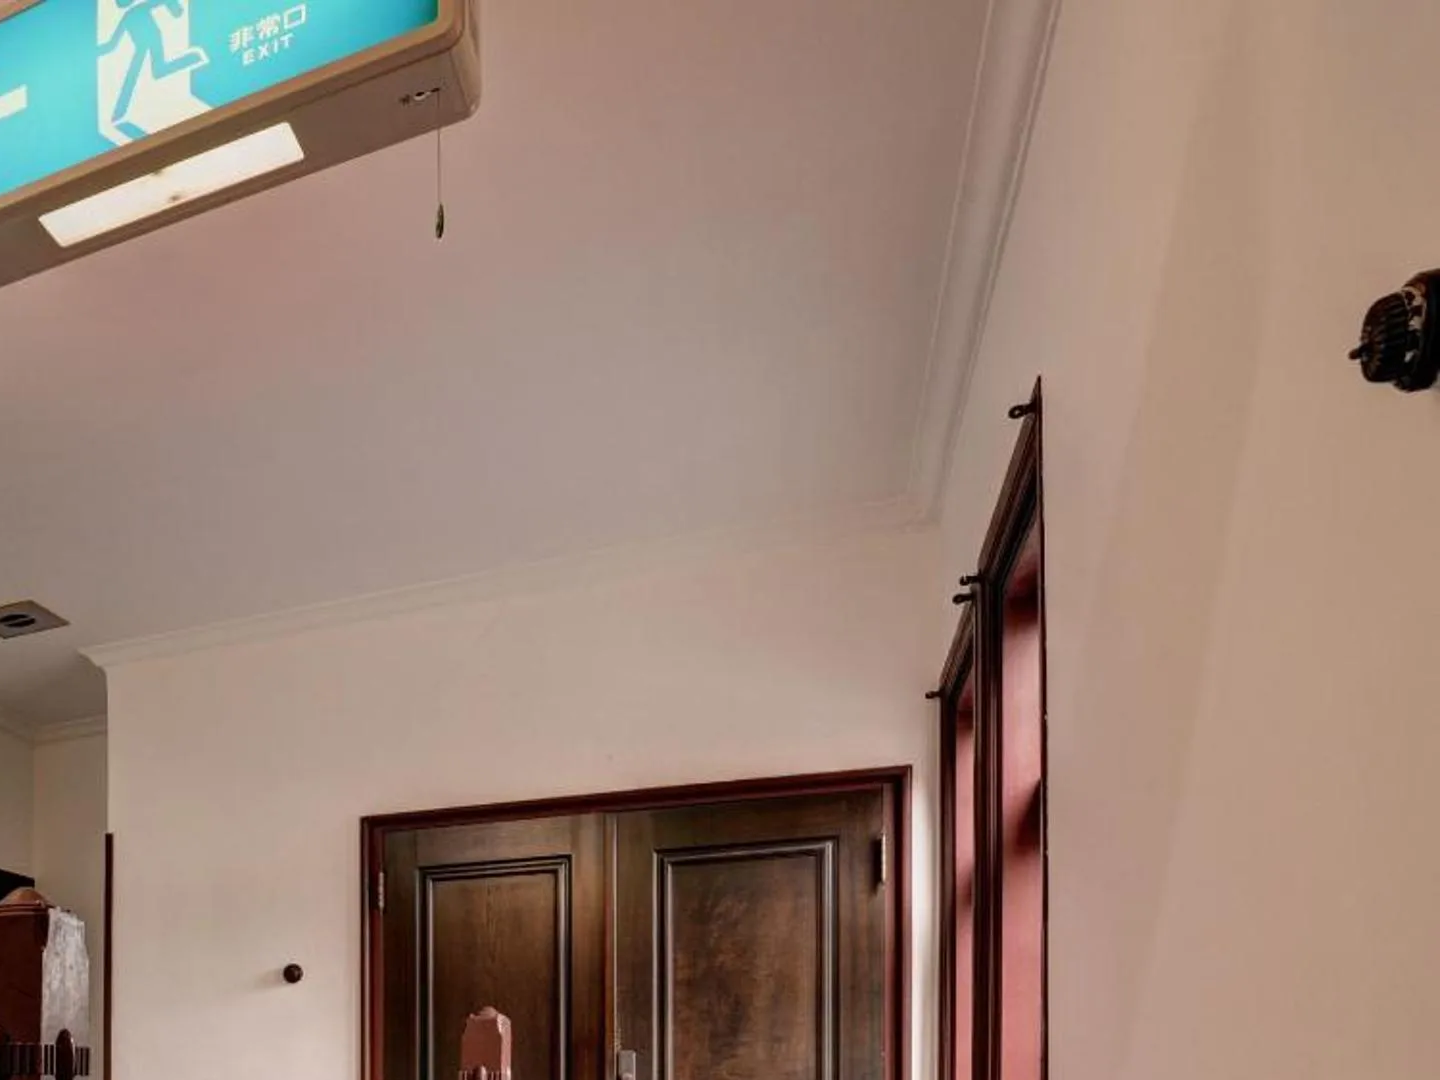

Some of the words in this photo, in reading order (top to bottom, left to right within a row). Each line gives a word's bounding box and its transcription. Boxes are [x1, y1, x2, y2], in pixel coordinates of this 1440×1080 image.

[228, 4, 306, 53] 非常口
[242, 33, 294, 66] EXIT
